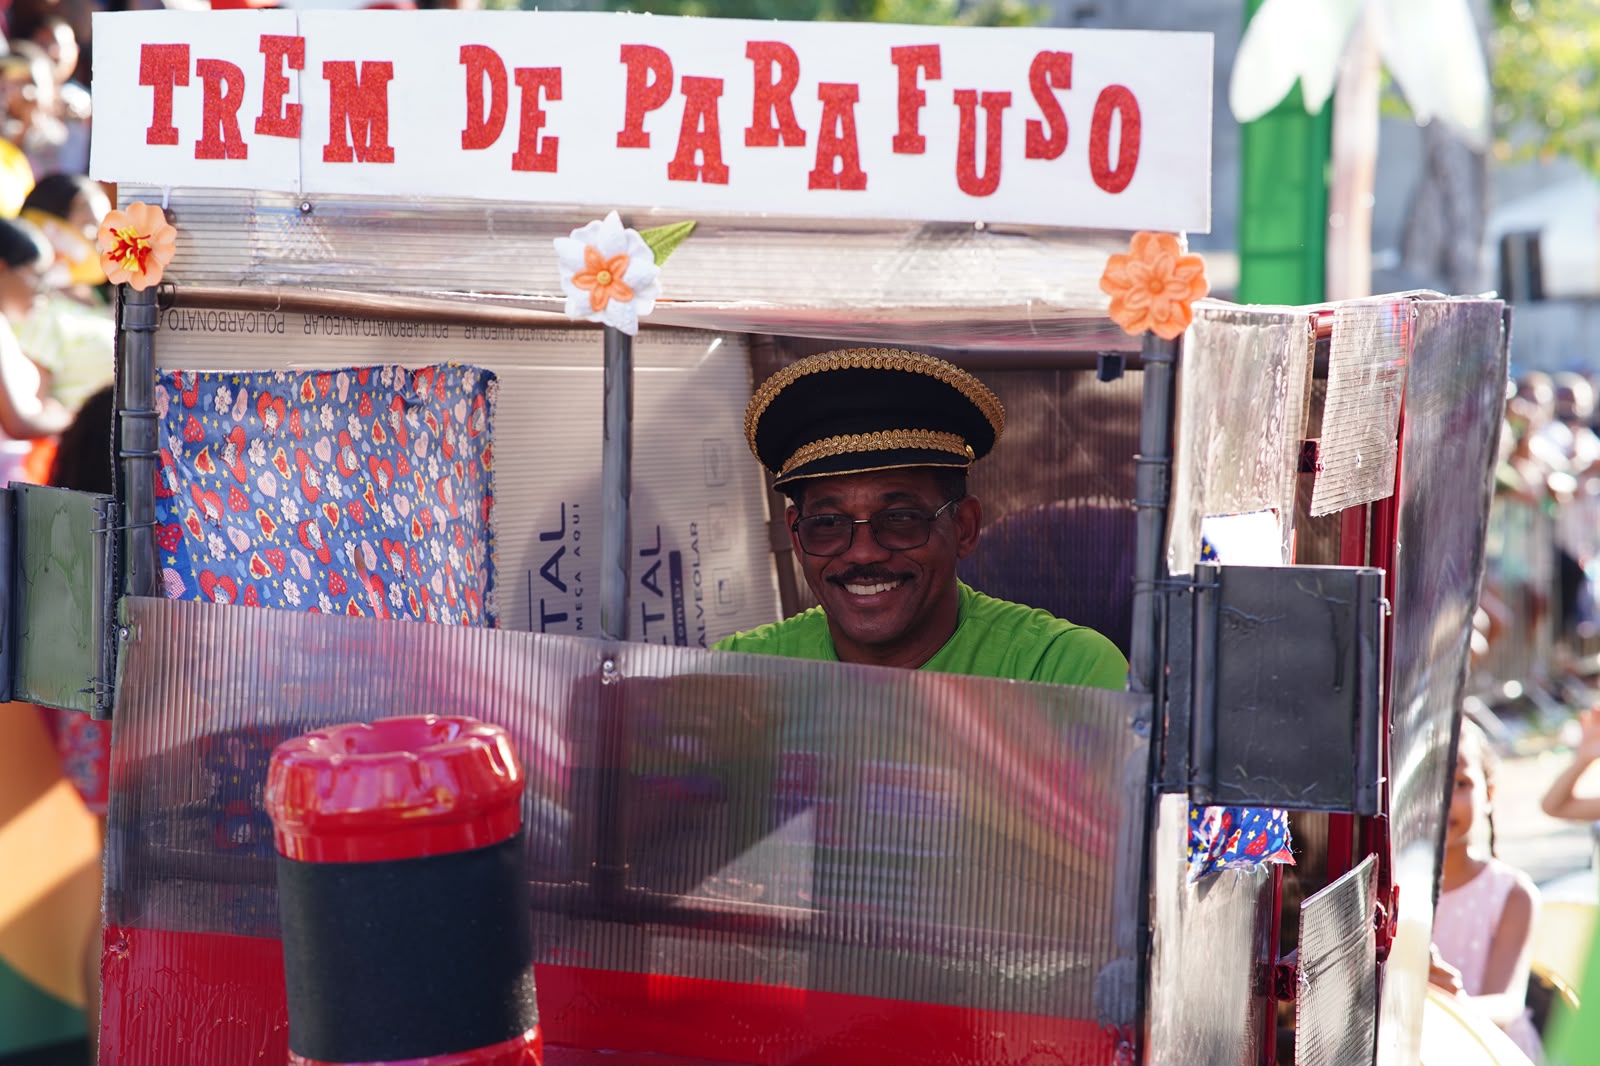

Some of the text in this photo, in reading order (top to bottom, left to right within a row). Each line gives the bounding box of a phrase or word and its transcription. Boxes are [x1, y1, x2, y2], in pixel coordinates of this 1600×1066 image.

[140, 35, 1141, 197] TREM DE PARAFUSO
[168, 308, 285, 334] POLICARBONATO
[303, 313, 360, 337] ALVEOLAR
[361, 318, 449, 339] POLICARBONATO
[572, 503, 582, 558] AQUI
[689, 521, 707, 649] ALVEOLAR
